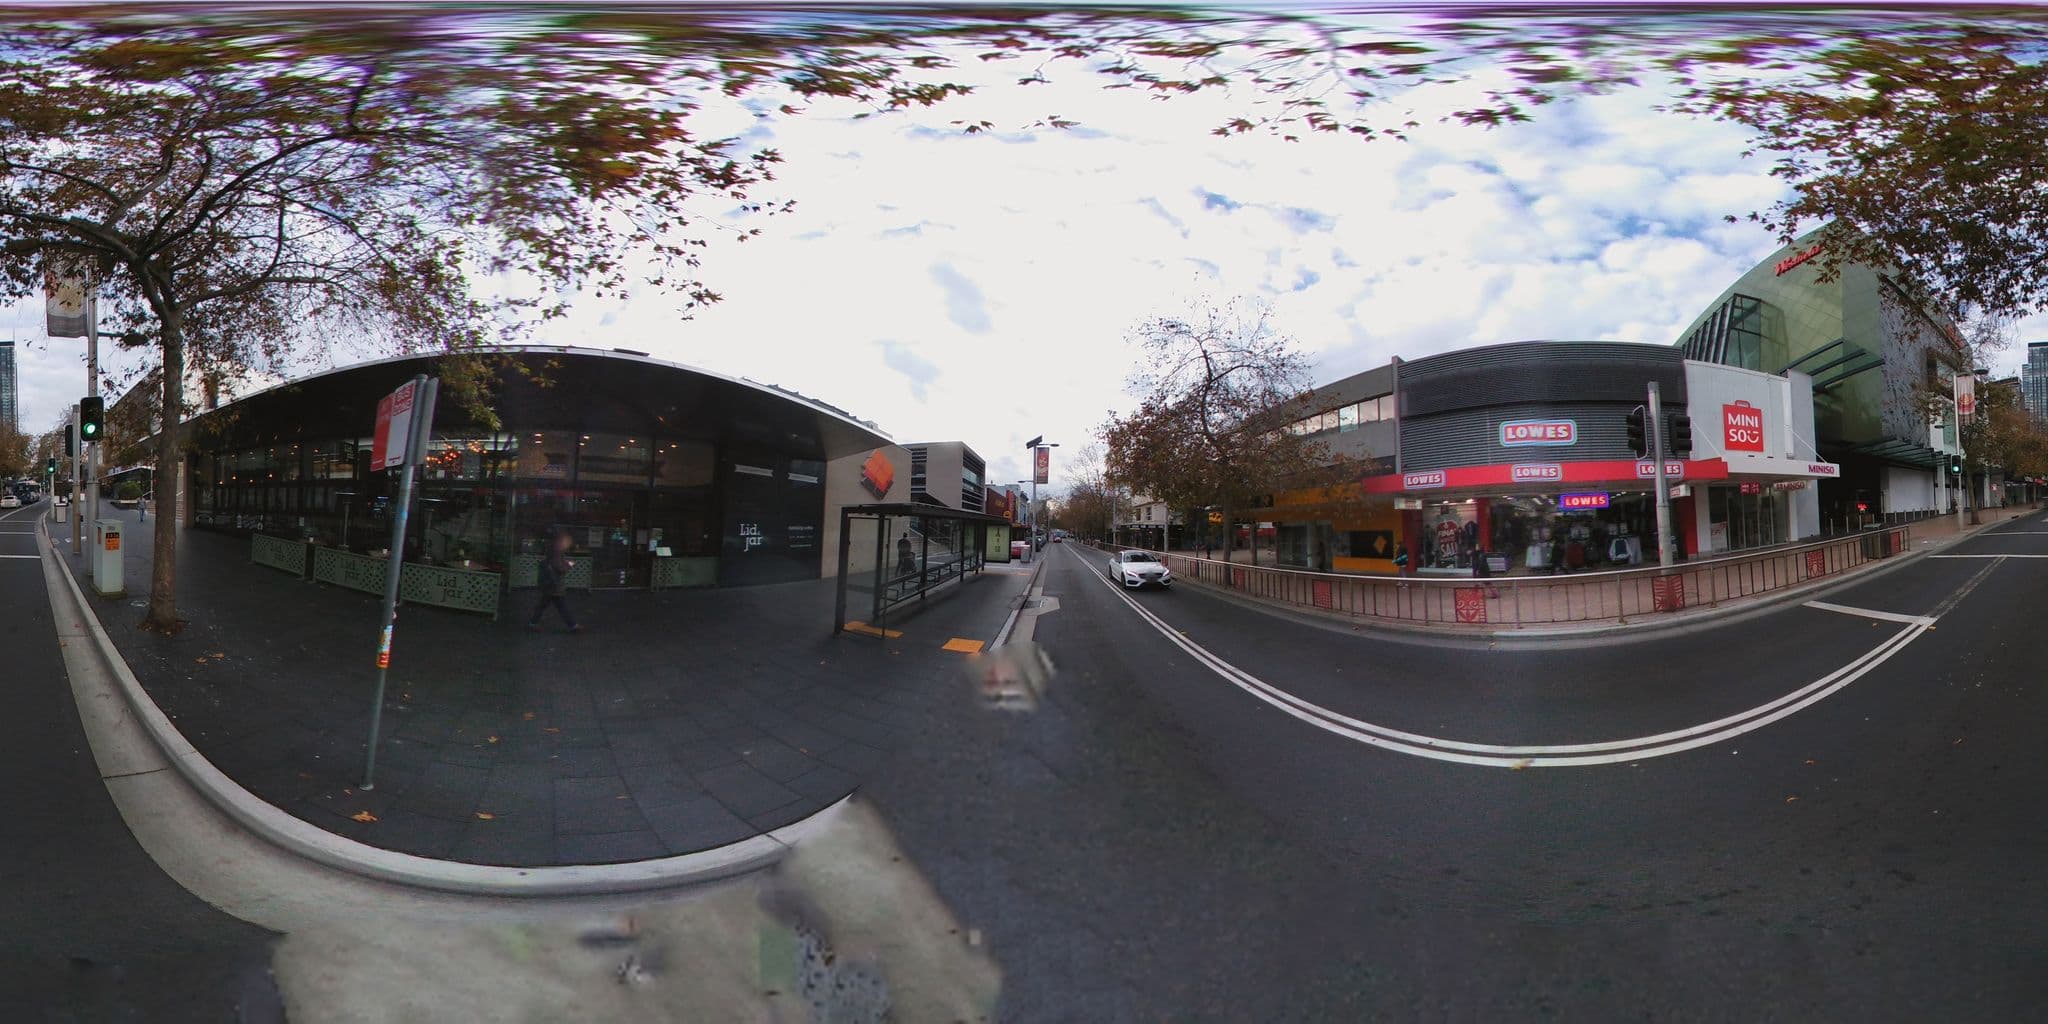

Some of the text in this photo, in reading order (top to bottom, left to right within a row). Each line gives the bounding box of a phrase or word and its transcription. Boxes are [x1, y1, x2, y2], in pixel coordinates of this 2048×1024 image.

[1728, 412, 1759, 428] MINI
[1506, 425, 1569, 439] LOWES
[1516, 467, 1557, 477] LOWES
[1641, 465, 1680, 474] LOES
[1808, 464, 1835, 475] MINISO
[1407, 475, 1441, 485] LOWES
[1565, 495, 1606, 506] LOWES
[743, 536, 763, 552] jar
[440, 588, 463, 602] jar
